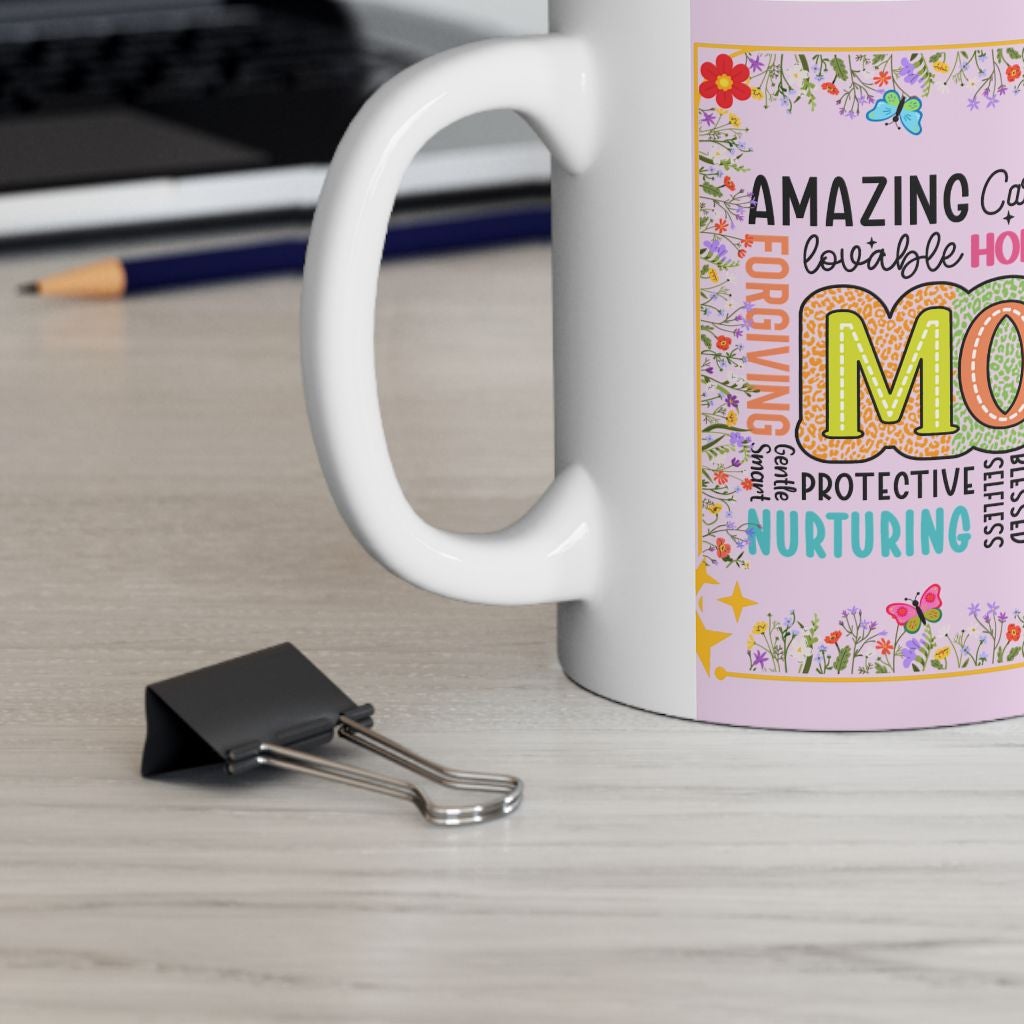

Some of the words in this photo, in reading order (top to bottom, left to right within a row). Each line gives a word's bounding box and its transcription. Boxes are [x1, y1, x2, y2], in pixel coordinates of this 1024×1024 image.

[748, 174, 970, 227] AMAZING
[803, 231, 964, 279] lovable
[745, 234, 791, 437] FORGIVING
[750, 443, 771, 503] Smart
[773, 443, 795, 502] Gentle
[802, 466, 975, 501] PROTECTIVE
[983, 456, 1004, 549] SELFLESS
[747, 505, 972, 559] NURTURING
